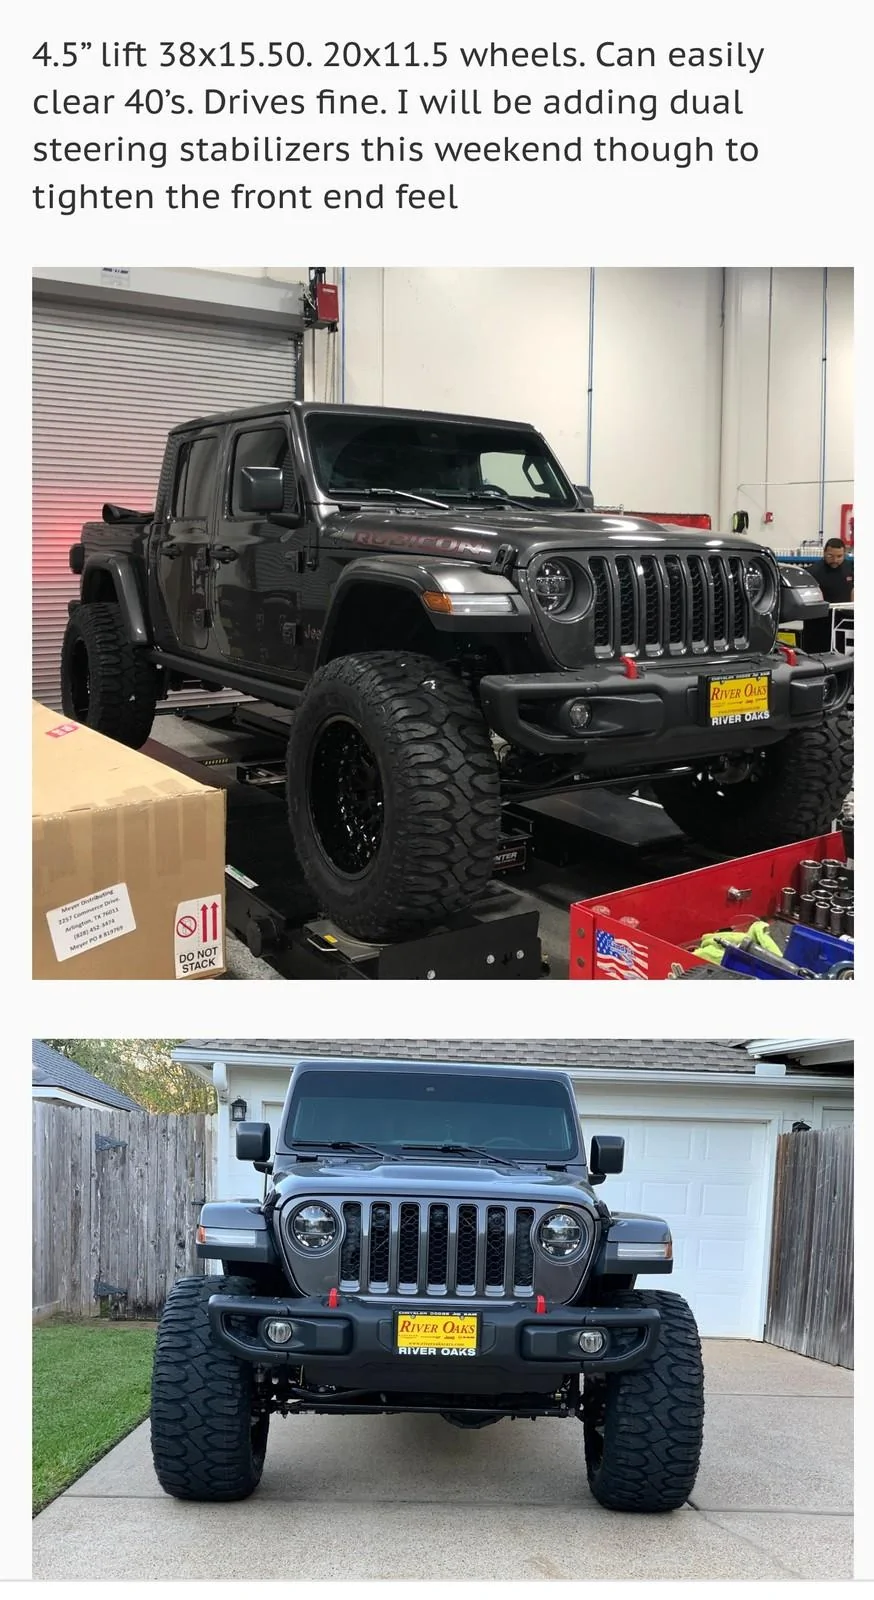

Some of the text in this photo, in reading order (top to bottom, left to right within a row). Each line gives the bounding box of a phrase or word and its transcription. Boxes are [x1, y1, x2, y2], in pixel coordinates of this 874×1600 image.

[353, 530, 485, 554] RUBICON
[304, 624, 321, 641] Jee
[711, 711, 770, 726] RIVER OAKS
[494, 852, 518, 862] NTER
[61, 890, 114, 913] Meyer Distributing
[73, 904, 103, 919] Commerce
[69, 941, 89, 952] Meyer
[89, 936, 98, 944] PO
[179, 946, 218, 964] DO NOT
[182, 957, 216, 974] STACK
[398, 1347, 476, 1356] RIVER OAKS
